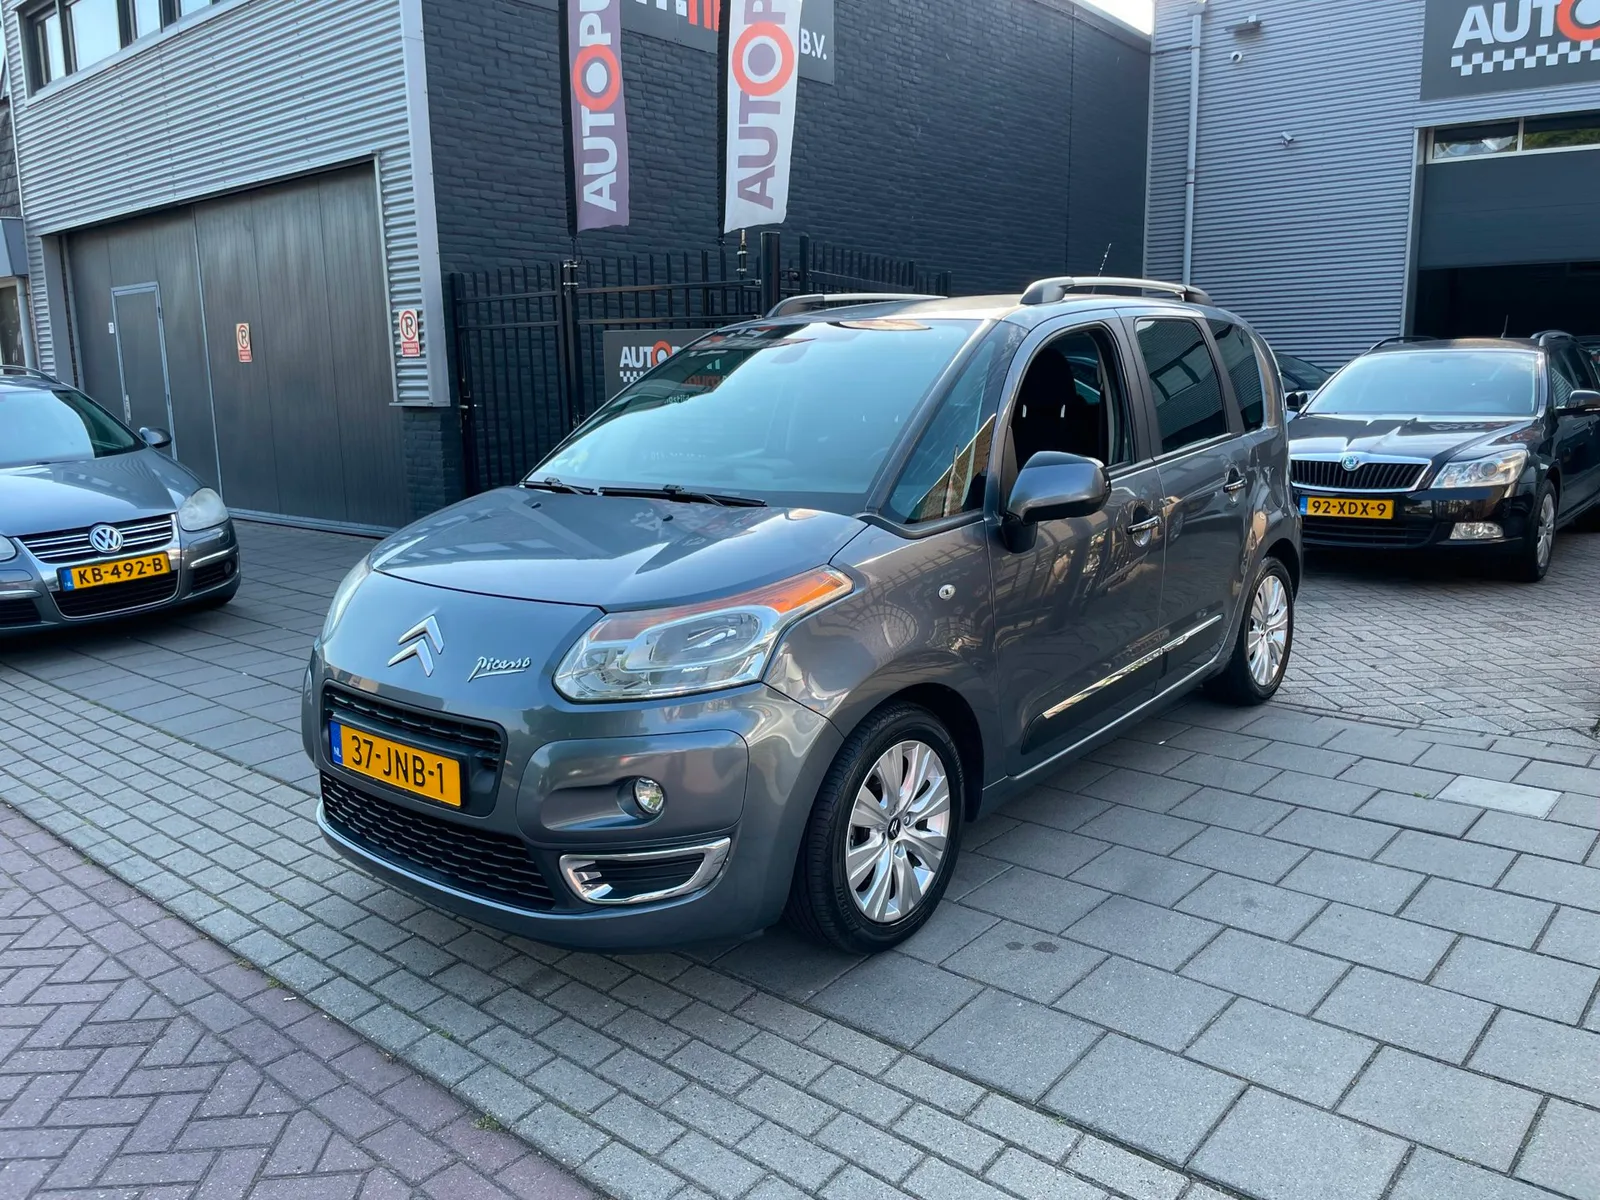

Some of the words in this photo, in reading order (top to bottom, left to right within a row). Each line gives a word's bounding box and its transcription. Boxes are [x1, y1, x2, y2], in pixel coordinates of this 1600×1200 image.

[800, 28, 827, 60] B.V.
[1312, 500, 1387, 516] 92-XDX-9
[78, 557, 163, 585] KB-492-B
[351, 733, 444, 794] 37-JNB-1
